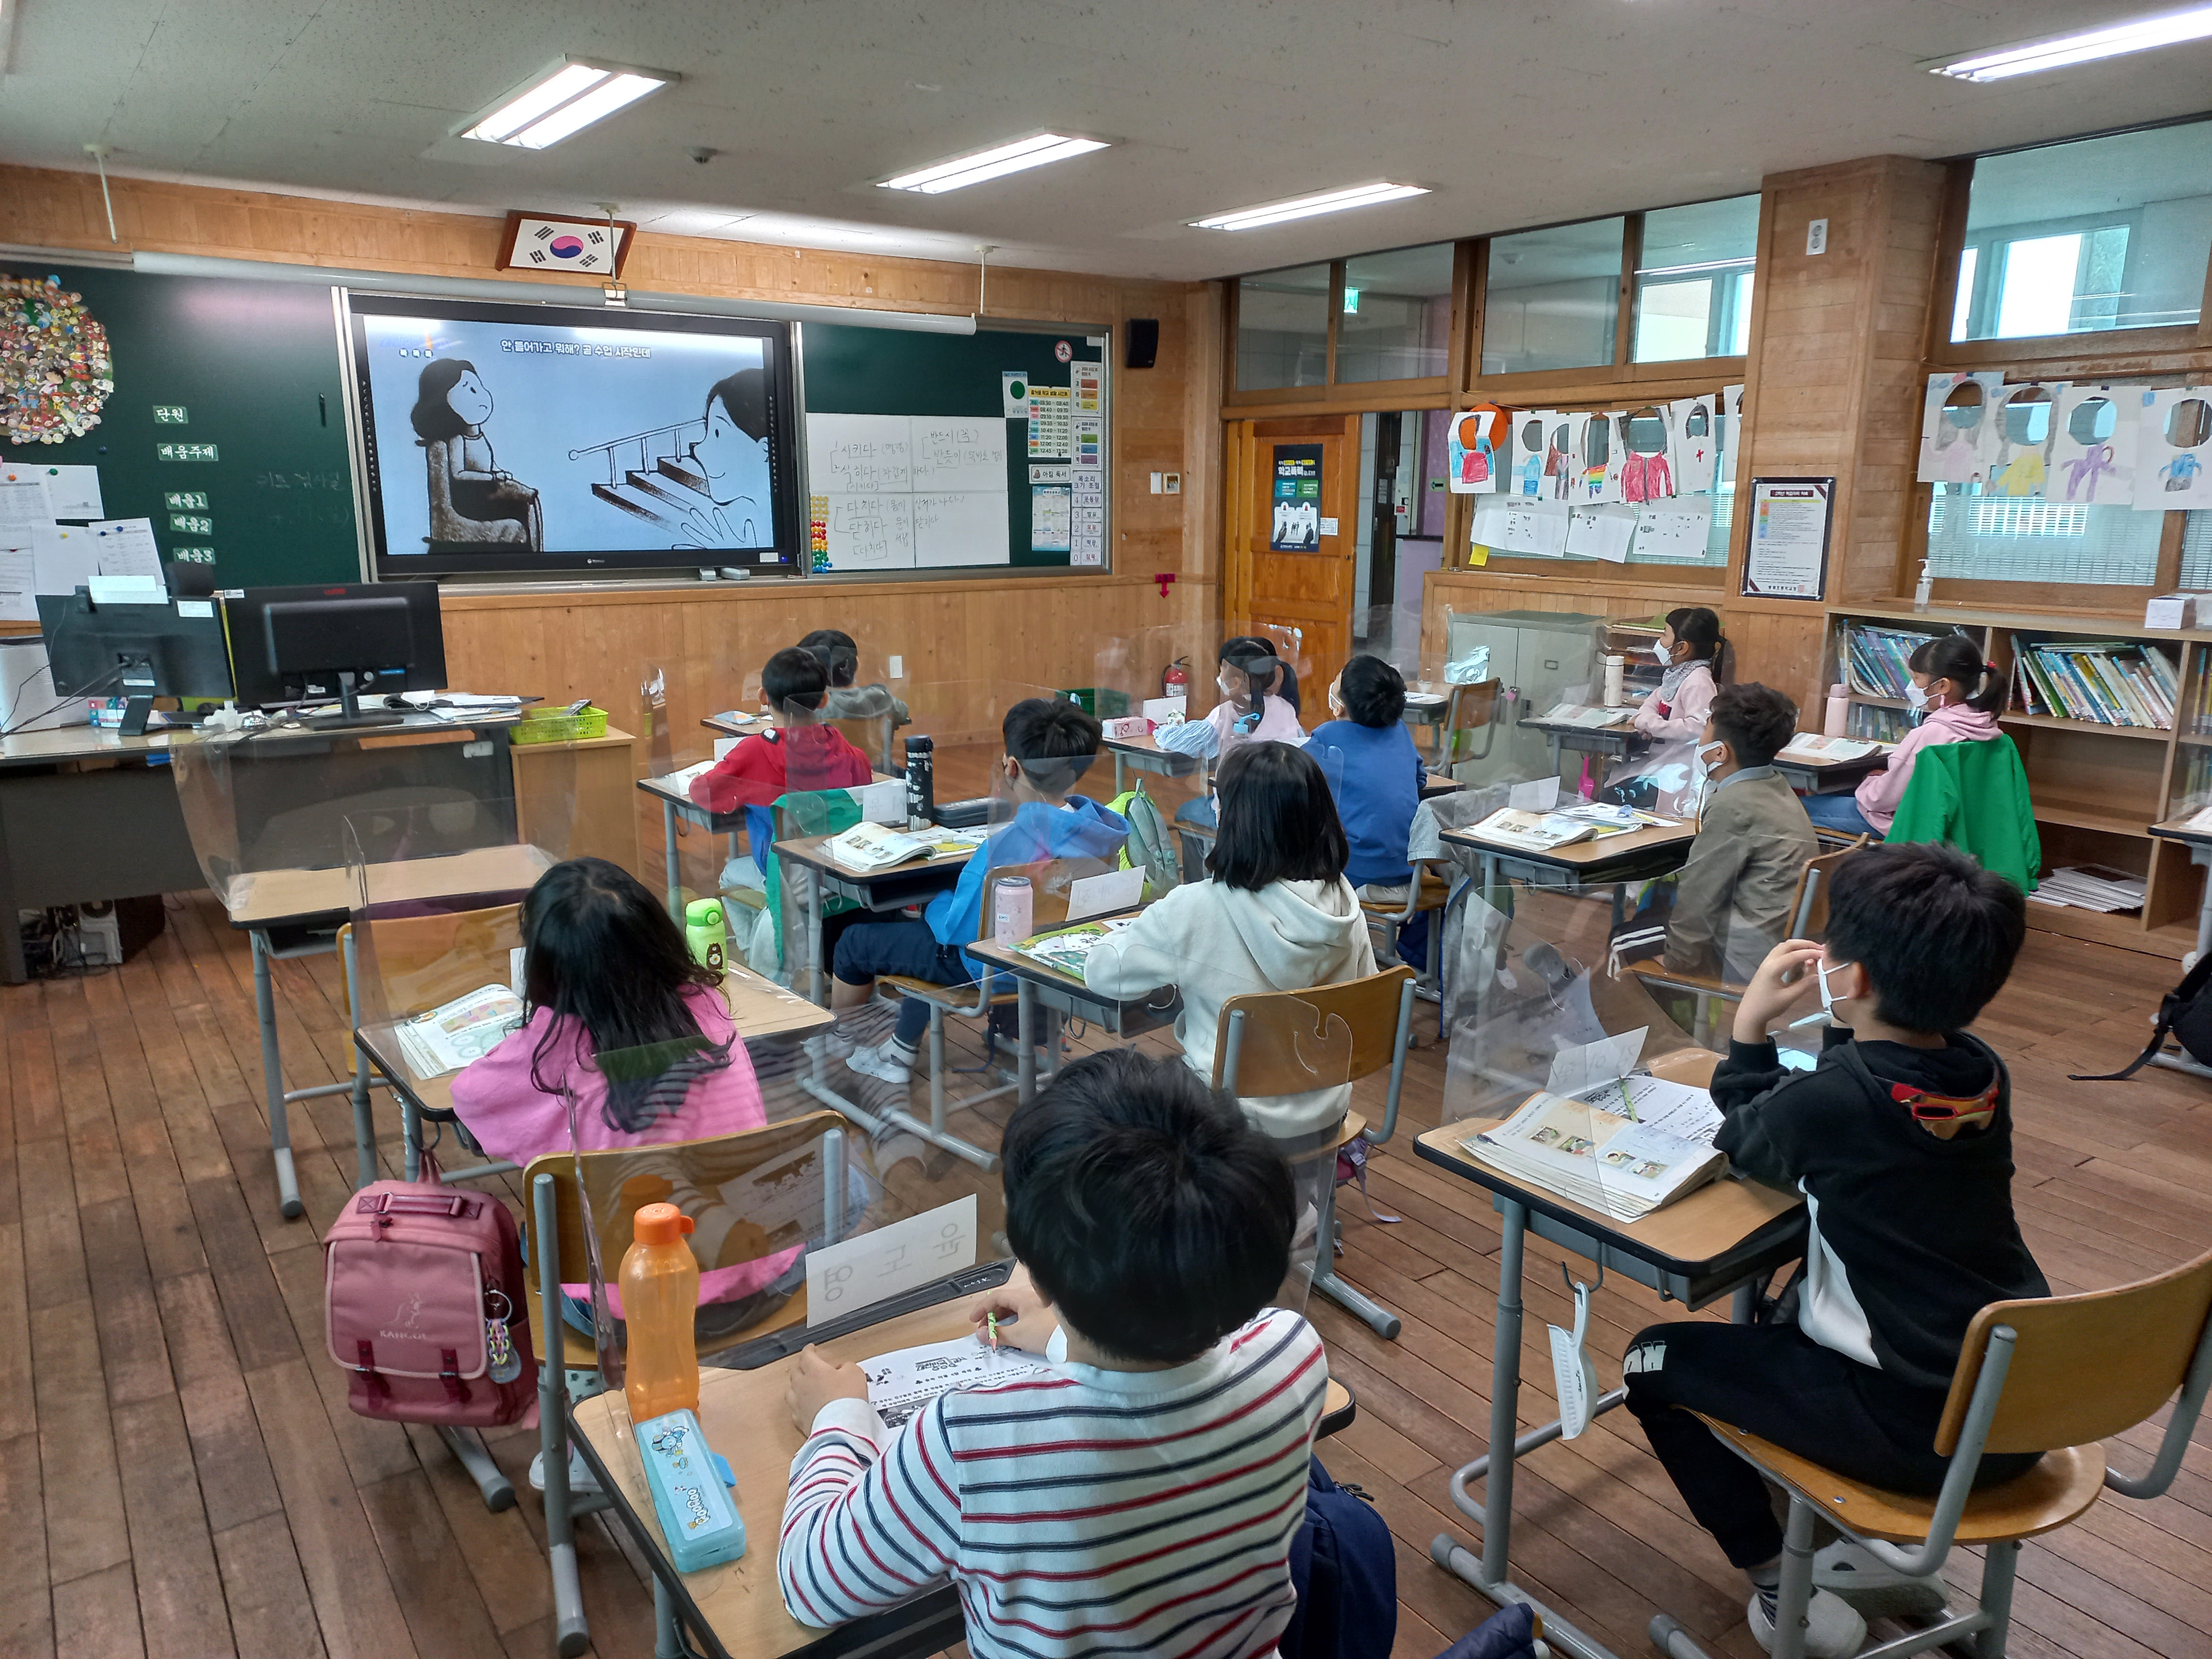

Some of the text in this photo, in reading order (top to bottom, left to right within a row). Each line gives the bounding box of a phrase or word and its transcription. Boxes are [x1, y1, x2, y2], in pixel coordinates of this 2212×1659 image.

[500, 339, 512, 352] 안
[514, 340, 553, 353] 들어가고
[554, 342, 580, 355] 뭐해?
[594, 345, 612, 356] 수업
[615, 346, 651, 358] 시작인데
[156, 408, 184, 422] 단원
[930, 429, 953, 444] 반드시
[160, 445, 214, 459] 배움주제
[841, 443, 877, 458] 시키다
[934, 451, 960, 466] 반듯이
[840, 465, 876, 483] 식히다
[169, 493, 204, 509] 배움1
[847, 498, 883, 516] 다치다
[915, 498, 936, 511] 상처가
[174, 515, 209, 532] 배움2
[177, 548, 212, 564] 배움3
[1080, 936, 1101, 944] 국어
